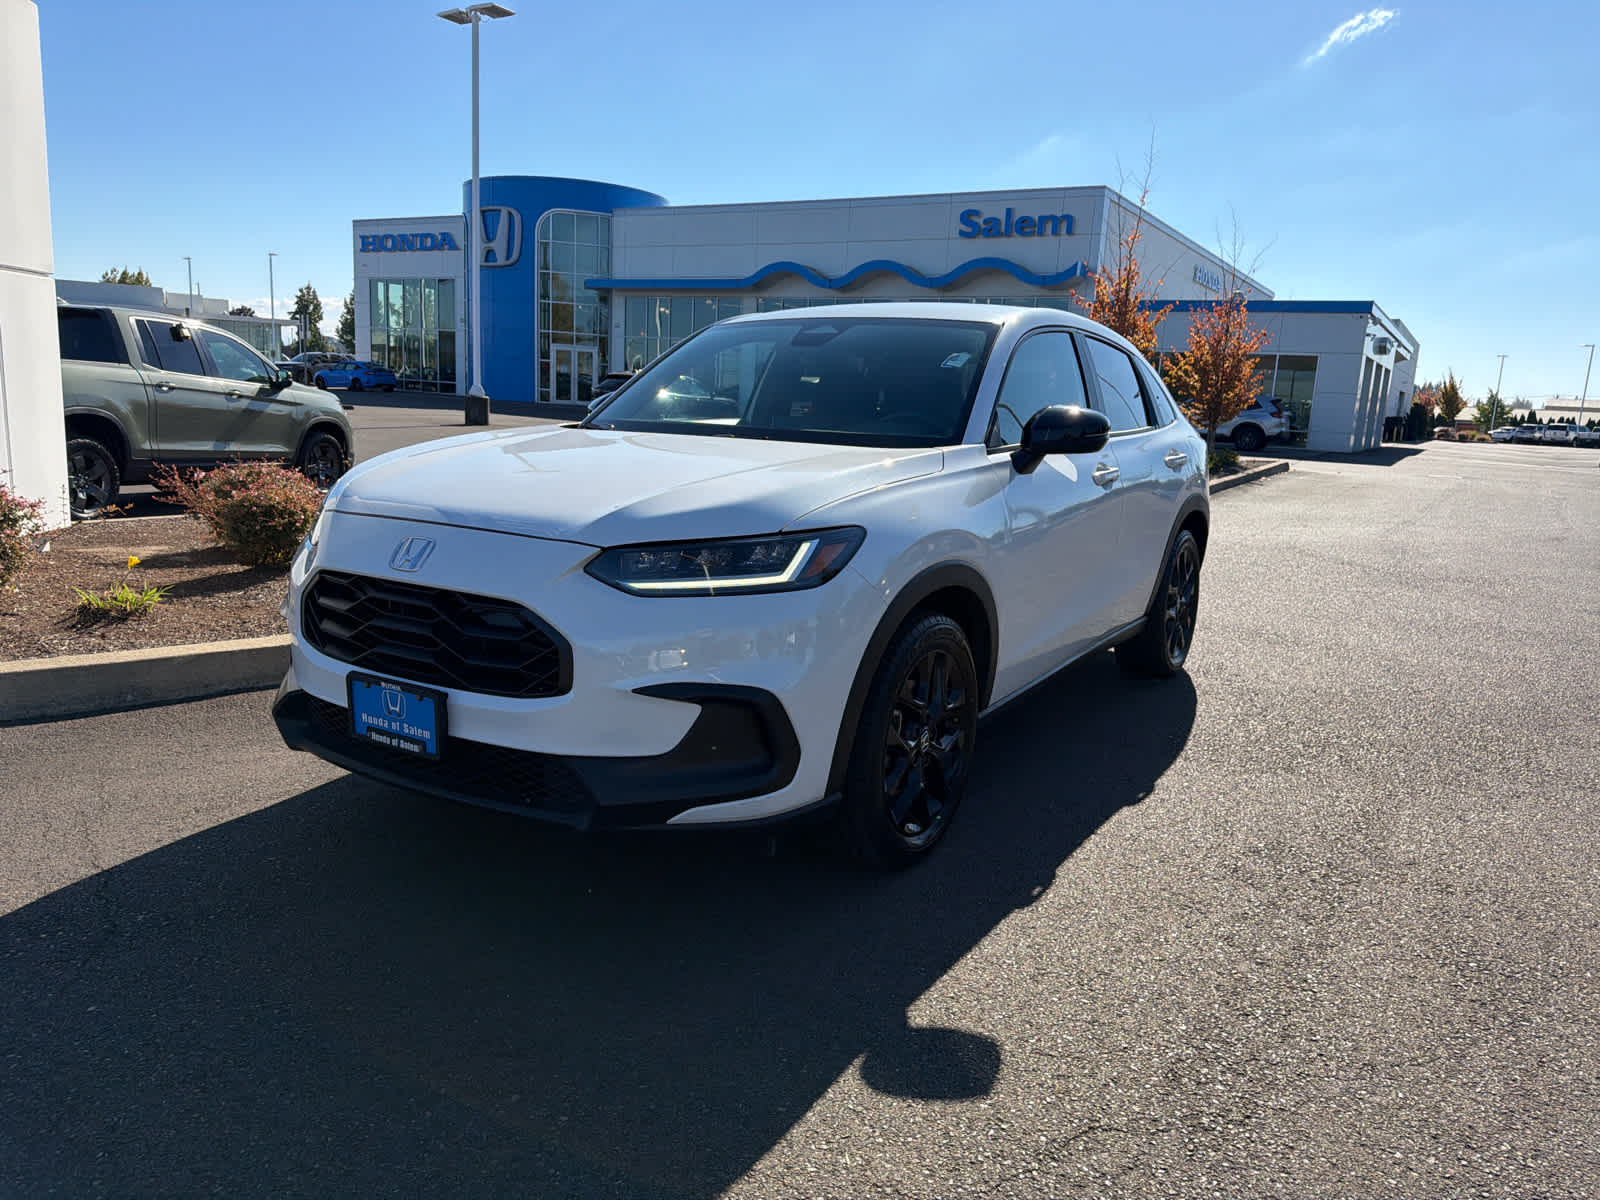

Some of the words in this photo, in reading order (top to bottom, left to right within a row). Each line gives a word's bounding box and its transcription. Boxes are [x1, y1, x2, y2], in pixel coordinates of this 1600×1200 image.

[958, 207, 1075, 238] Salem
[359, 231, 460, 252] HONDA
[361, 712, 388, 729] Honda
[391, 721, 400, 731] of
[403, 722, 431, 740] Salem
